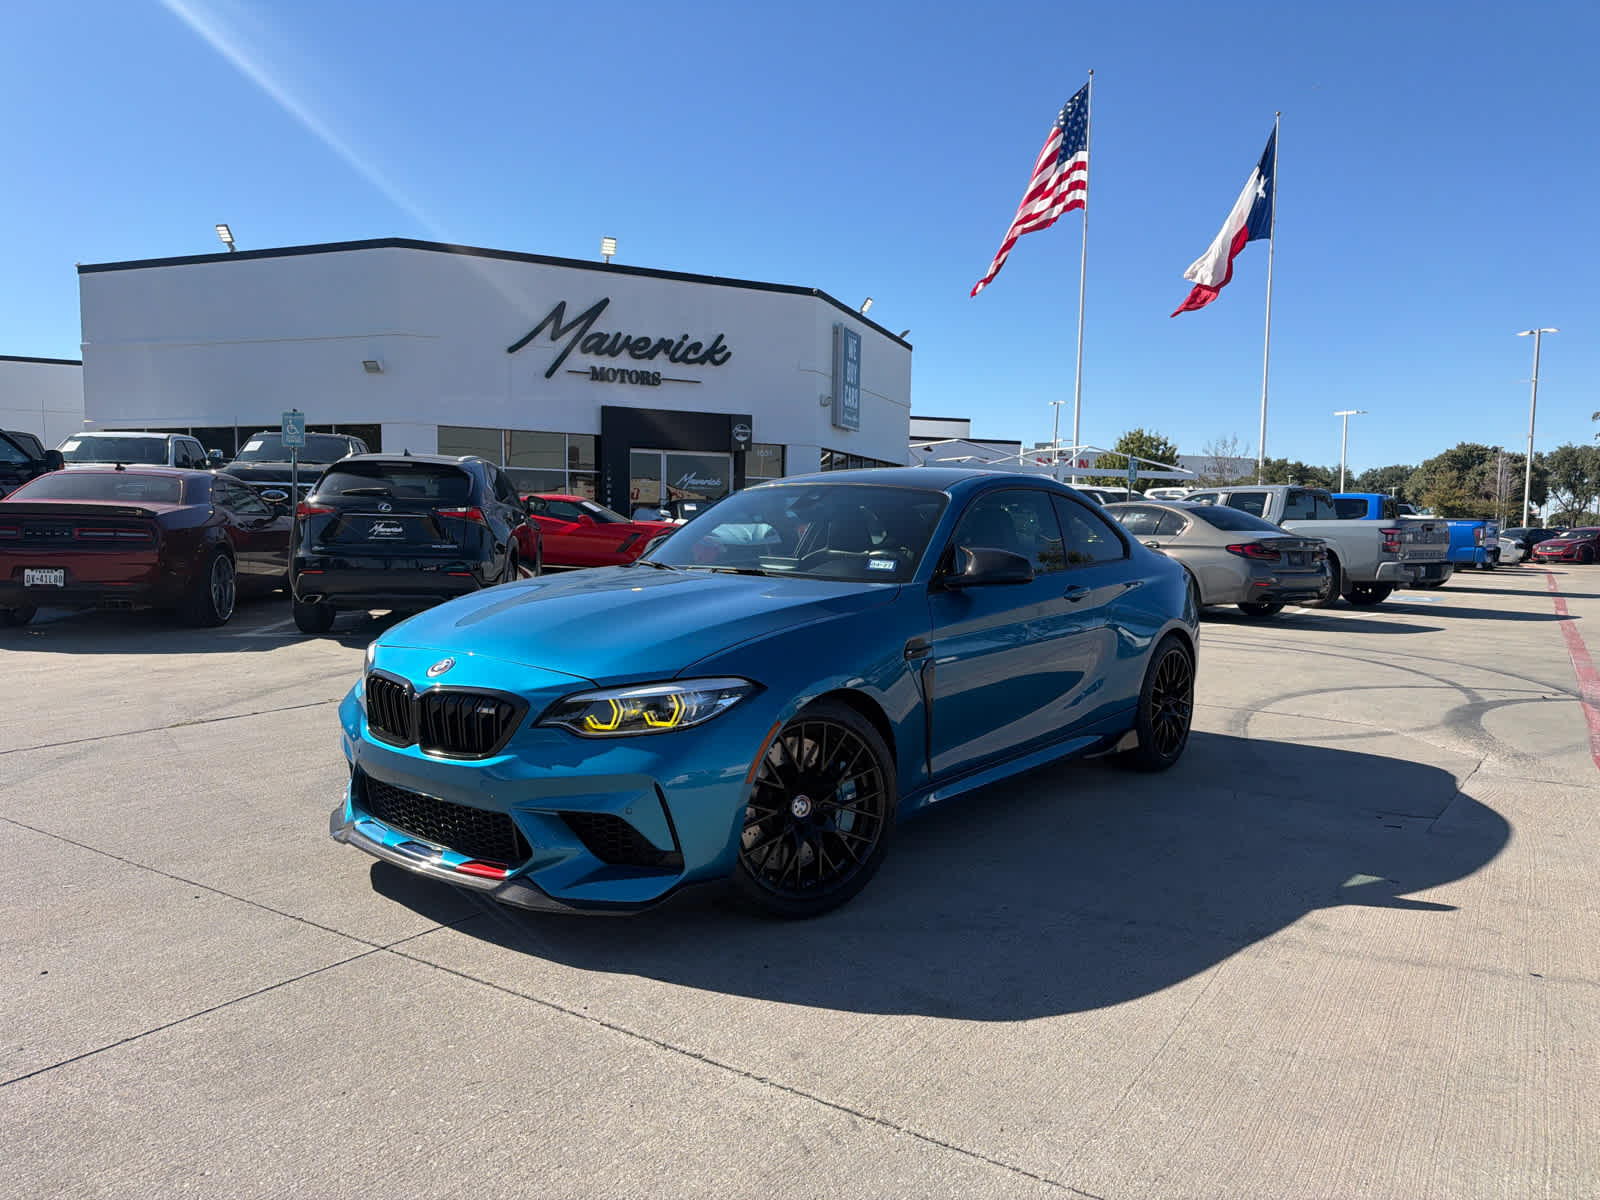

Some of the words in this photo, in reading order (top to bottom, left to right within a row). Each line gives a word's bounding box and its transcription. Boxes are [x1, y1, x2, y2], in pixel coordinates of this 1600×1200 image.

[507, 297, 732, 378] Maverick
[590, 366, 662, 386] MOTORS
[844, 385, 858, 409] CARS
